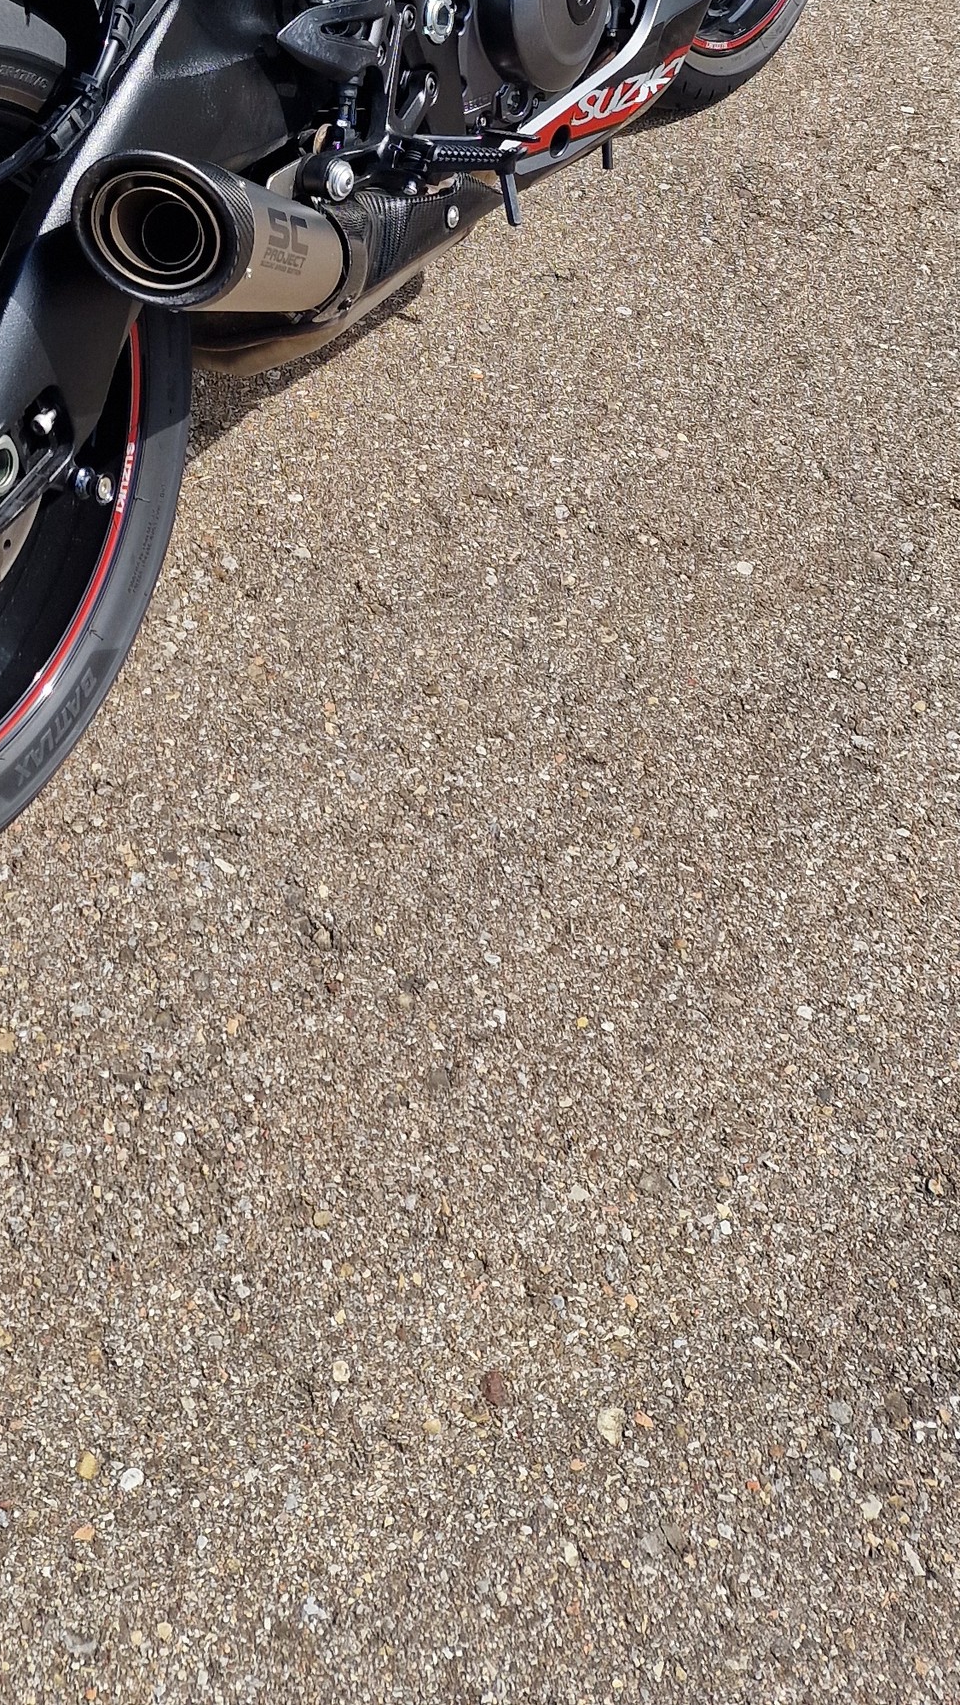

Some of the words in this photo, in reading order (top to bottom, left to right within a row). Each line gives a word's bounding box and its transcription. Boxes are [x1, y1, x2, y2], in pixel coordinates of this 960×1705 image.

[263, 247, 307, 269] PROJECT
[267, 207, 309, 256] SC
[116, 442, 136, 513] SUZUKI
[14, 666, 98, 787] BATTLAX
